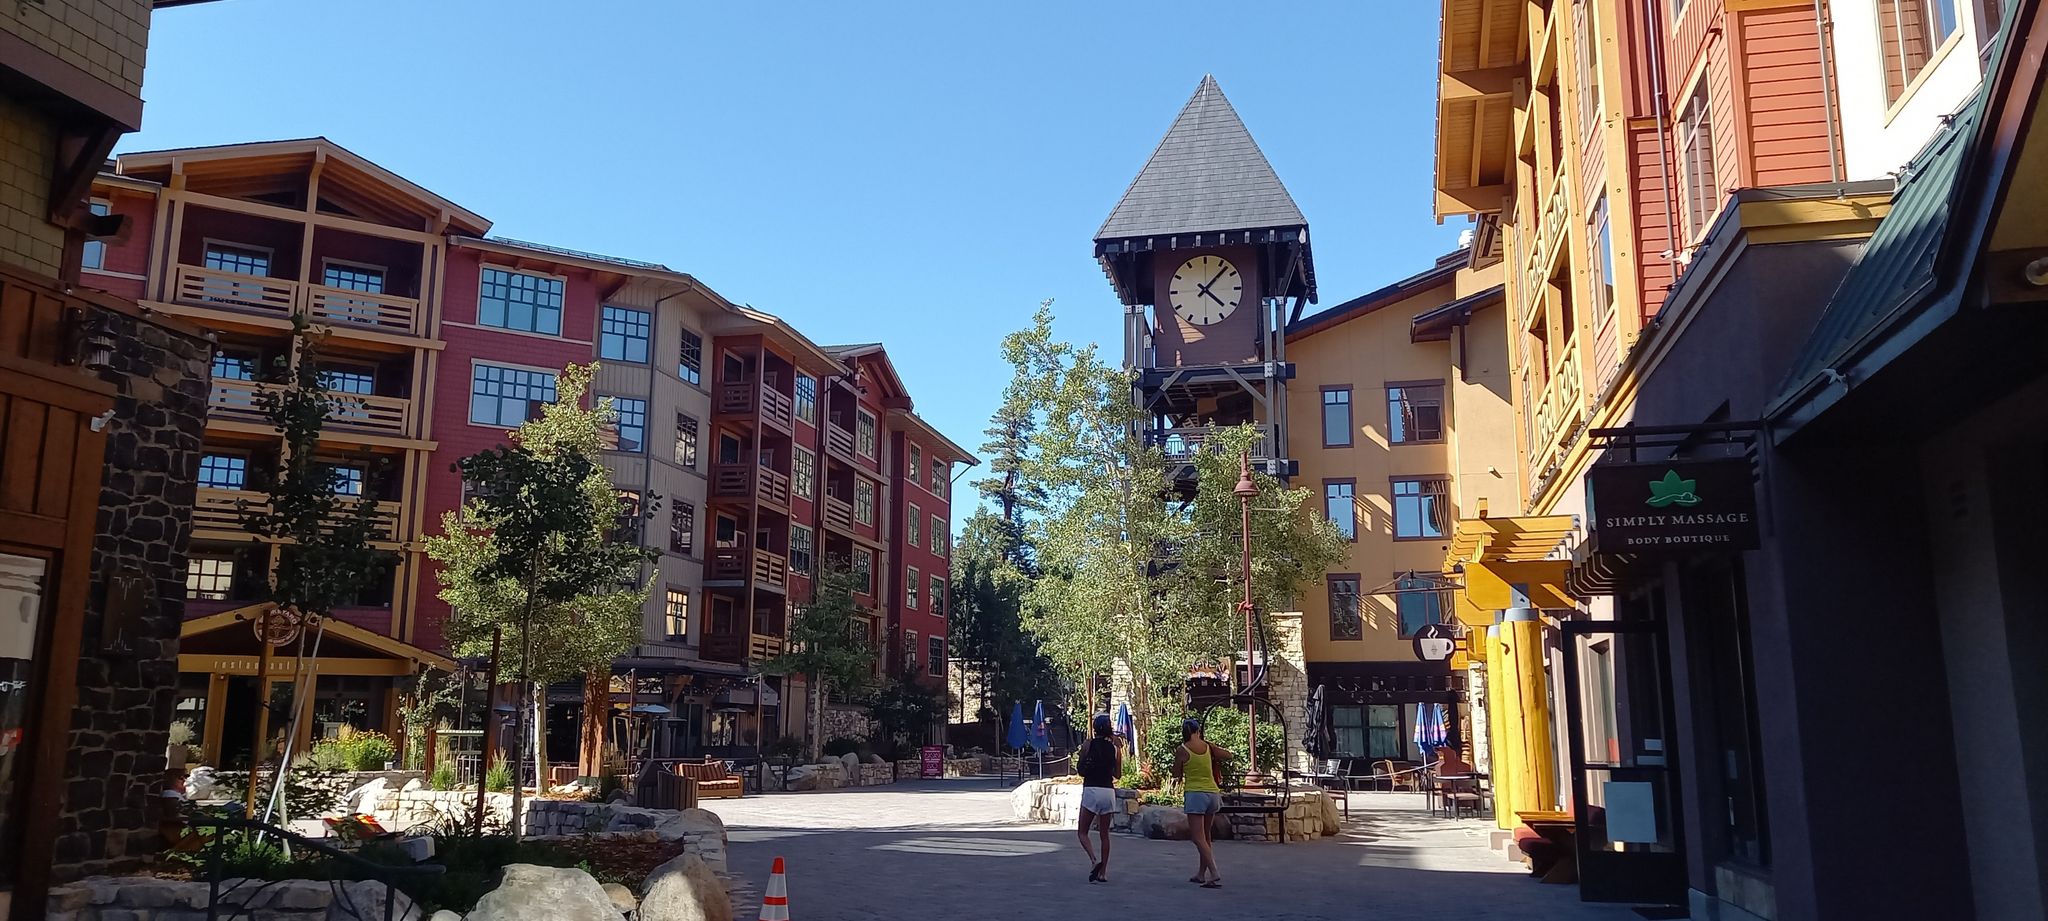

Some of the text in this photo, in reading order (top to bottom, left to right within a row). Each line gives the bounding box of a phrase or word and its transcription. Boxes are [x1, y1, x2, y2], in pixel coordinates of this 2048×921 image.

[1606, 513, 1750, 528] SIMPLY MASSAGE
[1628, 534, 1731, 545] BODY BOUTIQUE
[214, 660, 290, 670] restauant
